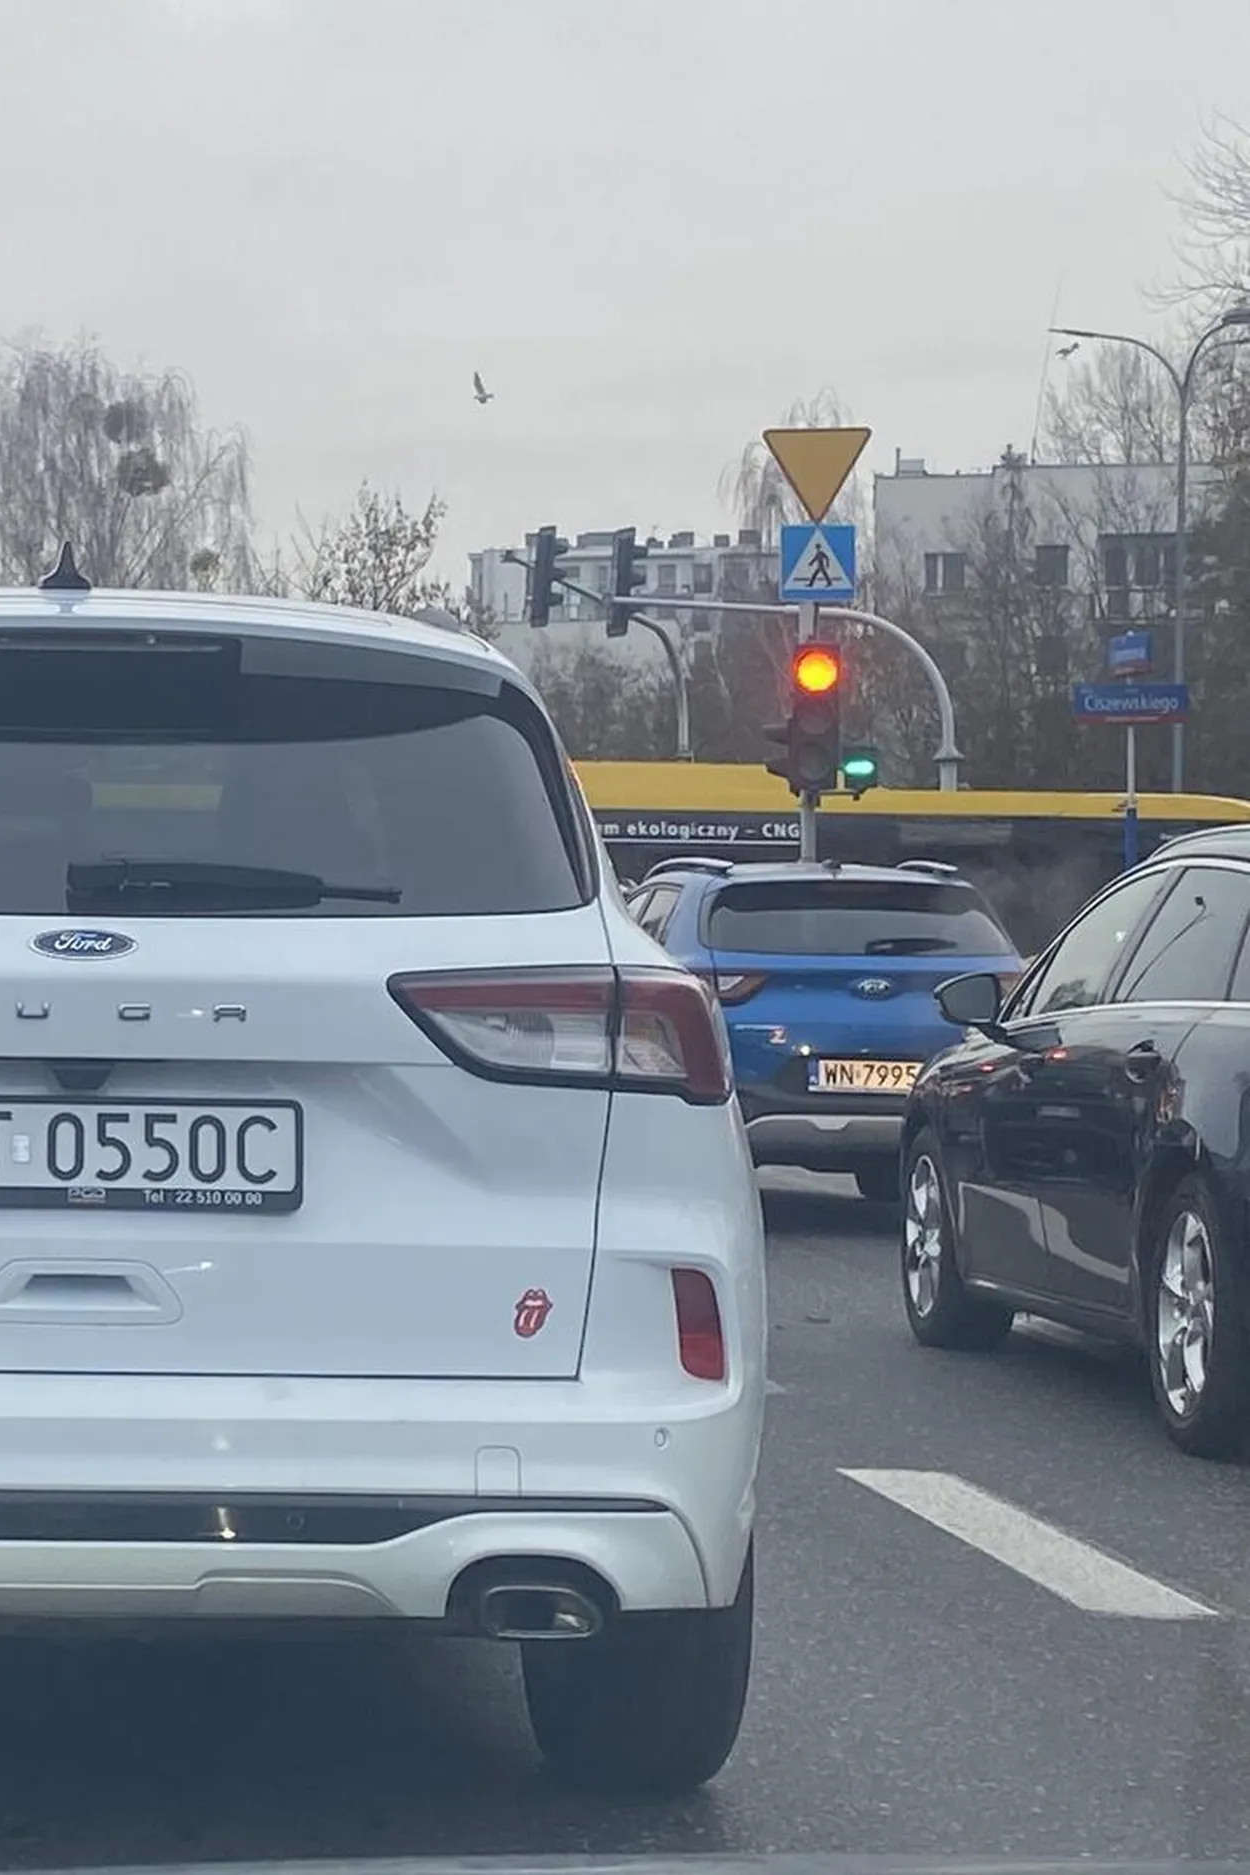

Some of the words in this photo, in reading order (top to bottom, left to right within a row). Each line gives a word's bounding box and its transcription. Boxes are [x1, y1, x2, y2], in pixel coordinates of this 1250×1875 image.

[627, 821, 739, 842] ekologiczny
[762, 823, 799, 838] CNG
[54, 932, 111, 951] Ford
[824, 1064, 854, 1084] WN
[863, 1064, 916, 1086] 7995
[47, 1112, 278, 1184] 0550C
[175, 1191, 193, 1204] 22
[197, 1191, 221, 1205] 510
[225, 1192, 242, 1205] 00
